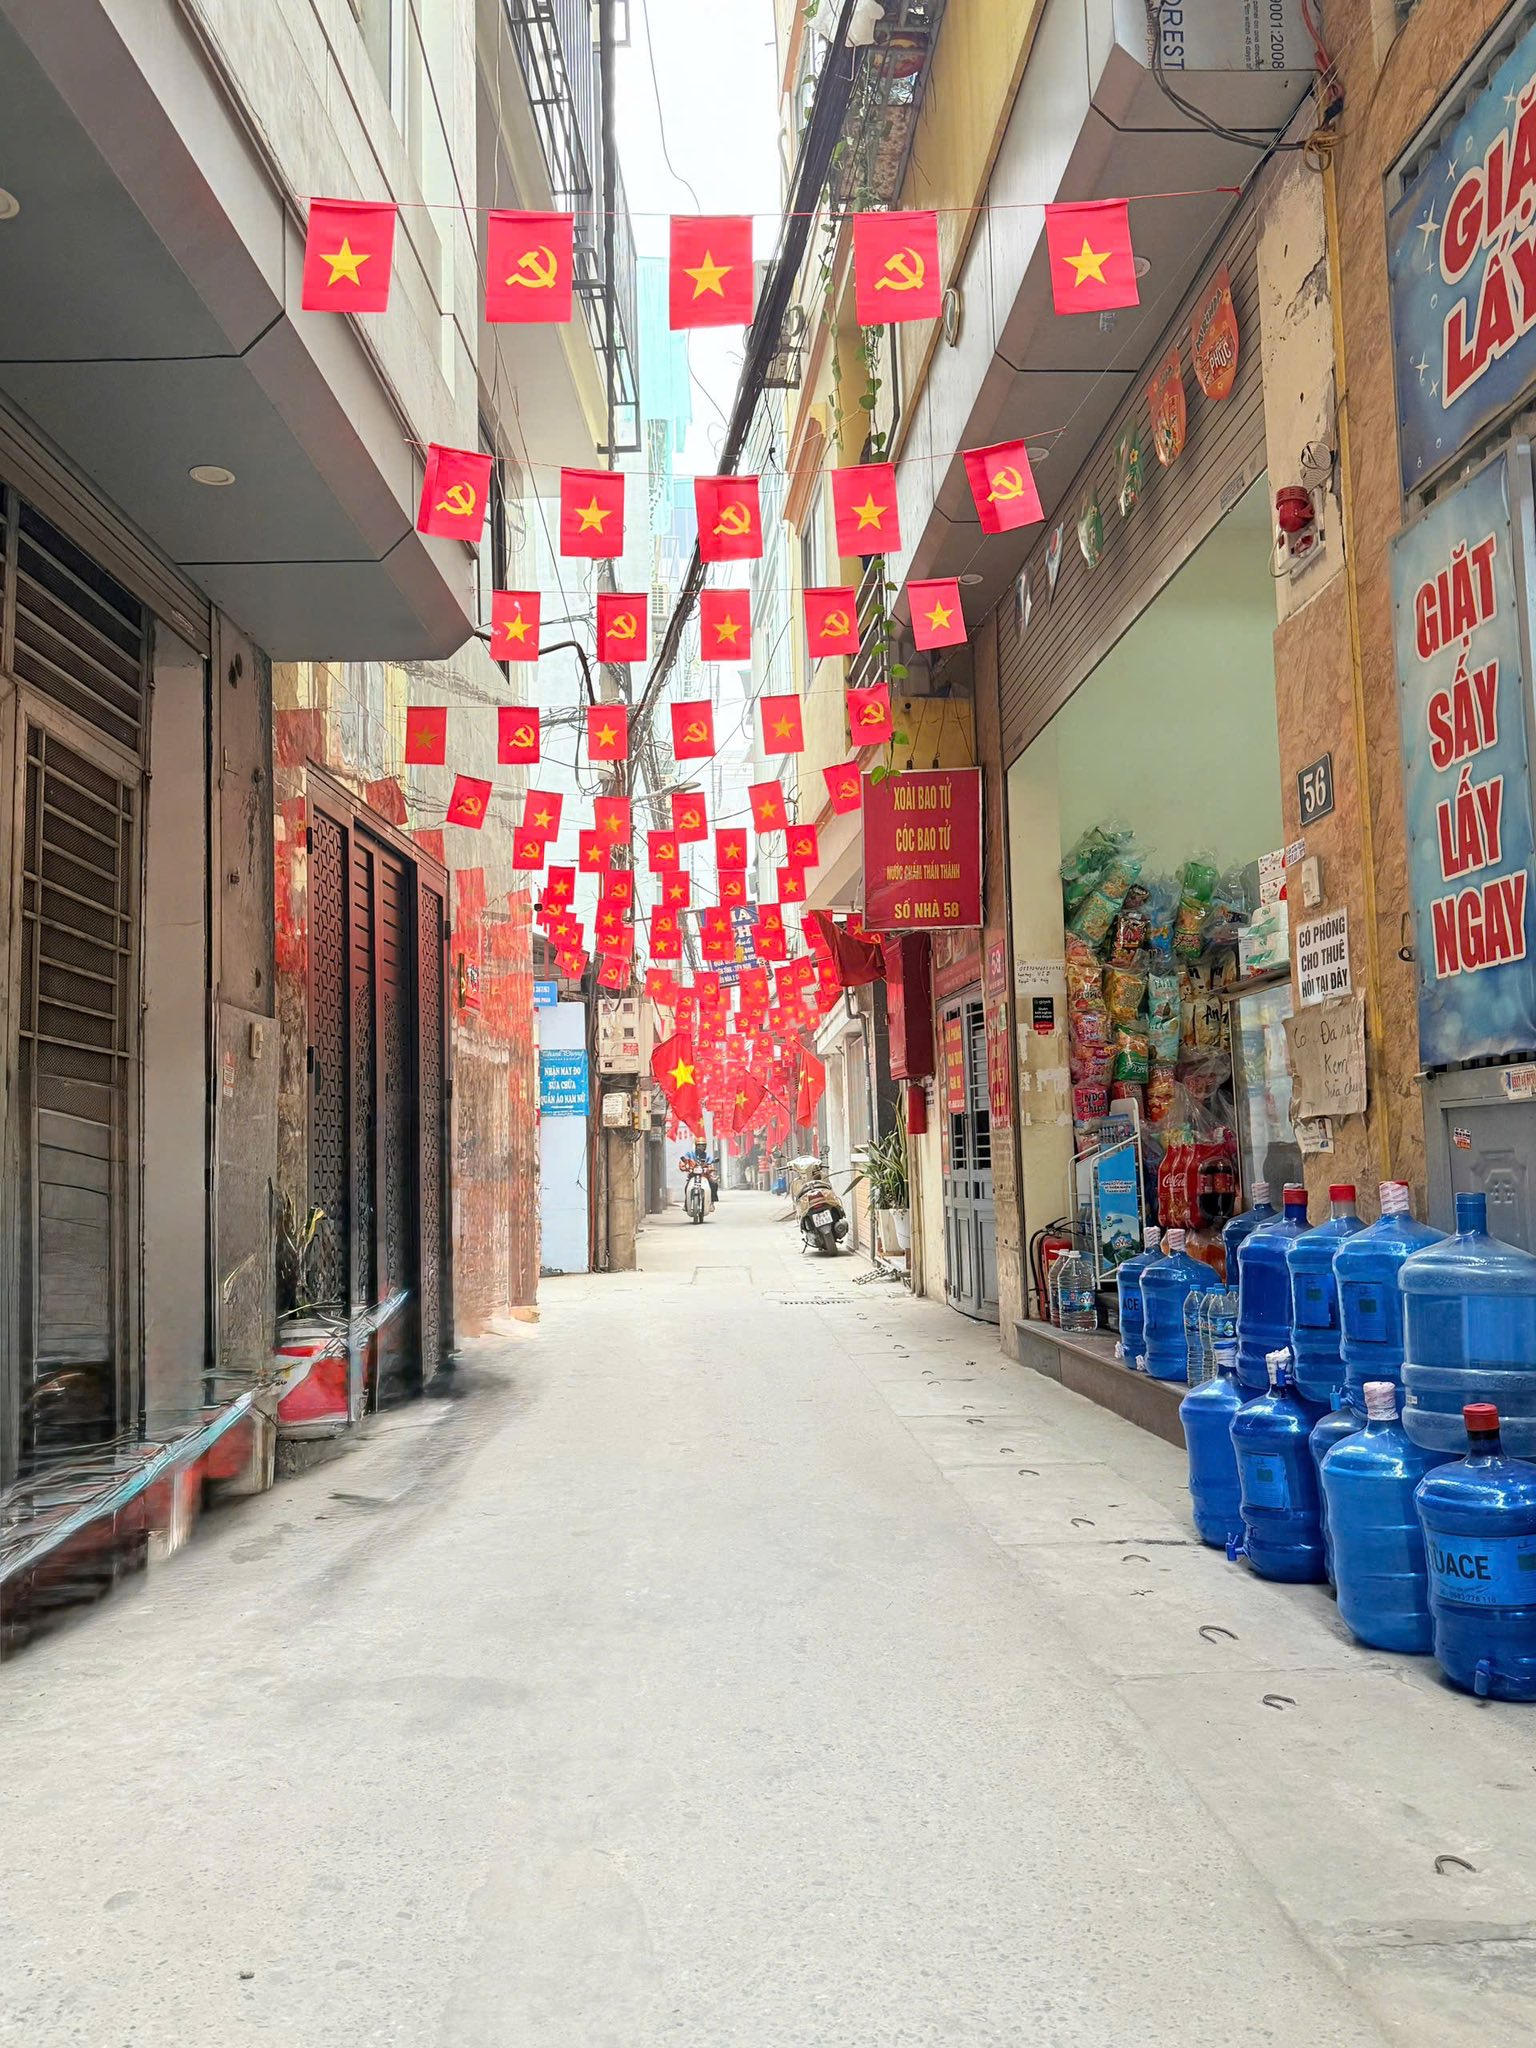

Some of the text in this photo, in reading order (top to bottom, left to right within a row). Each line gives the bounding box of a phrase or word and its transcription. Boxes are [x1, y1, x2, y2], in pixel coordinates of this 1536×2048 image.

[1415, 532, 1498, 662] GIẶT
[1427, 651, 1500, 773] SẤY
[893, 776, 952, 811] XOÀI BAO TỬ
[1303, 766, 1327, 813] 56
[896, 818, 952, 852] CÓC BAO TỬ
[1436, 763, 1503, 882] LẤY
[894, 897, 960, 919] SỐ NHÀ 58
[1430, 870, 1527, 979] NGAY
[1299, 917, 1345, 948] CÓ PHÒNG
[991, 949, 1001, 975] 58
[1301, 938, 1345, 972] CHO THUÊ
[1301, 973, 1315, 998] HỎI
[1330, 966, 1348, 990] ĐÂY
